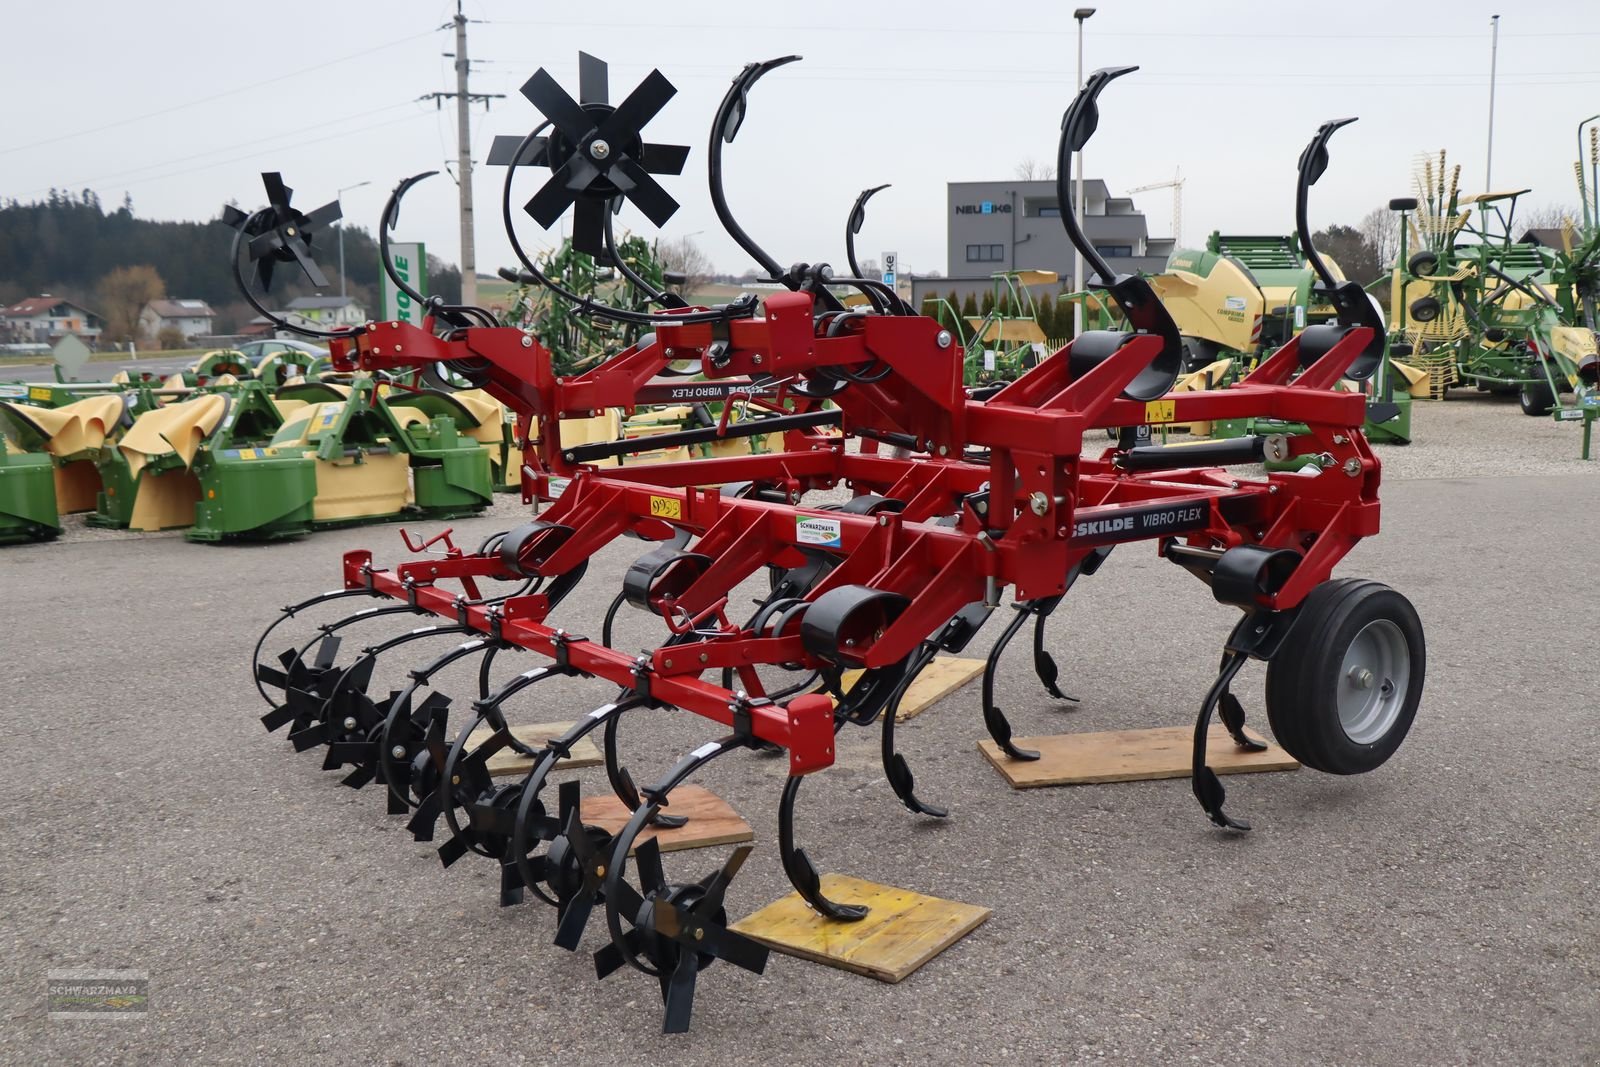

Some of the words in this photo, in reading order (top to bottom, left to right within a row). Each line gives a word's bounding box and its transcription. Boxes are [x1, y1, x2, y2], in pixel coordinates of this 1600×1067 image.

[672, 388, 694, 398] FLEX
[695, 387, 722, 397] VIBRO
[1143, 511, 1175, 528] VIBRO
[1177, 507, 1202, 523] FLEX
[799, 522, 835, 532] SCHWARZMAYR
